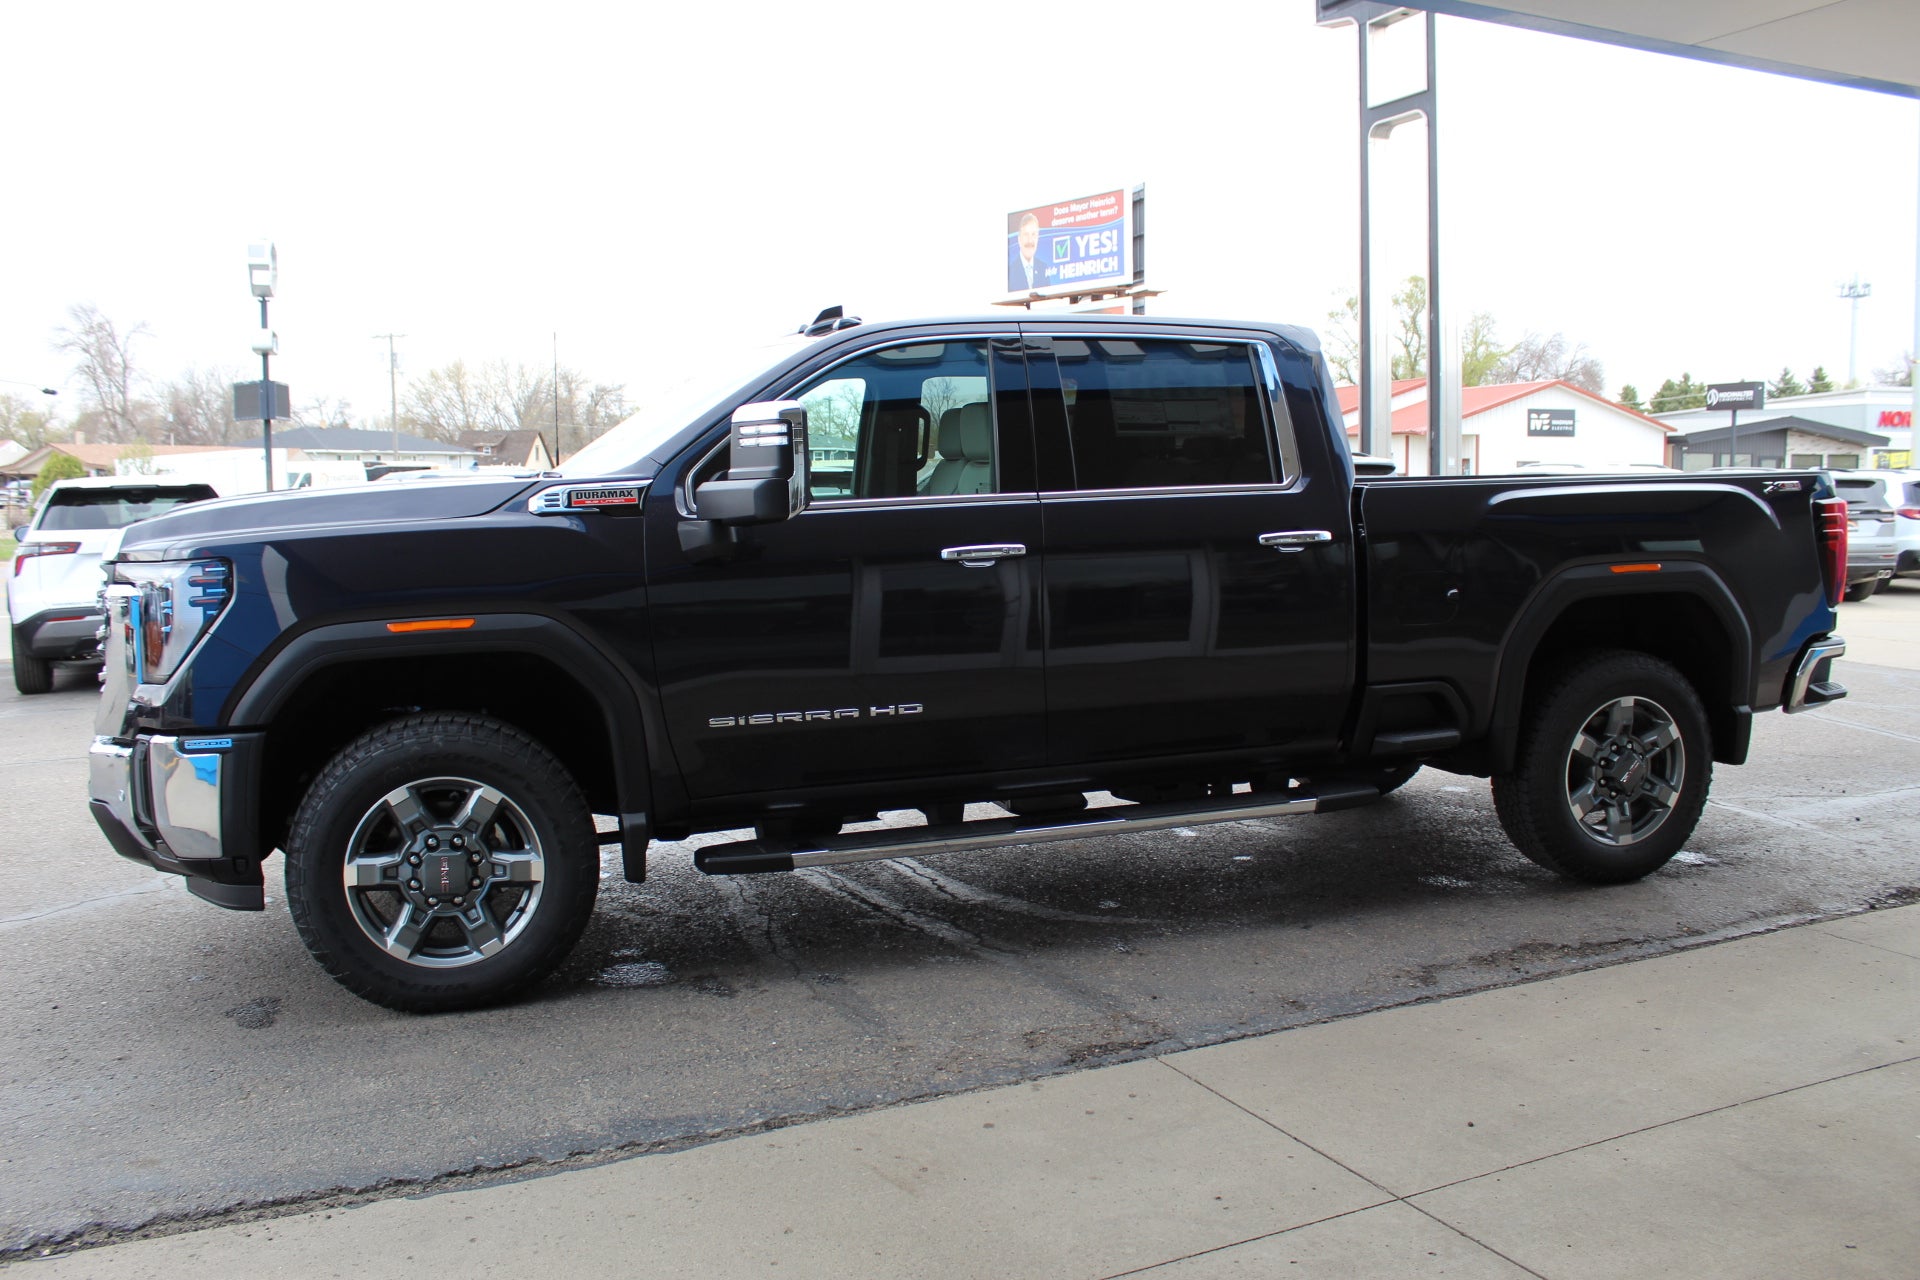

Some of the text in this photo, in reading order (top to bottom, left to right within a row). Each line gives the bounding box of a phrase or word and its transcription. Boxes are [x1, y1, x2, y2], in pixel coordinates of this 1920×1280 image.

[1051, 206, 1118, 226] deserve another term?
[1054, 196, 1115, 216] Does Mayor Heinrich
[1075, 229, 1118, 257] YES!
[1059, 256, 1118, 280] HEINRICH
[576, 490, 633, 499] DURAMAX
[708, 703, 924, 728] SIERRA HD
[186, 739, 230, 747] 2500
[440, 856, 450, 893] GMC
